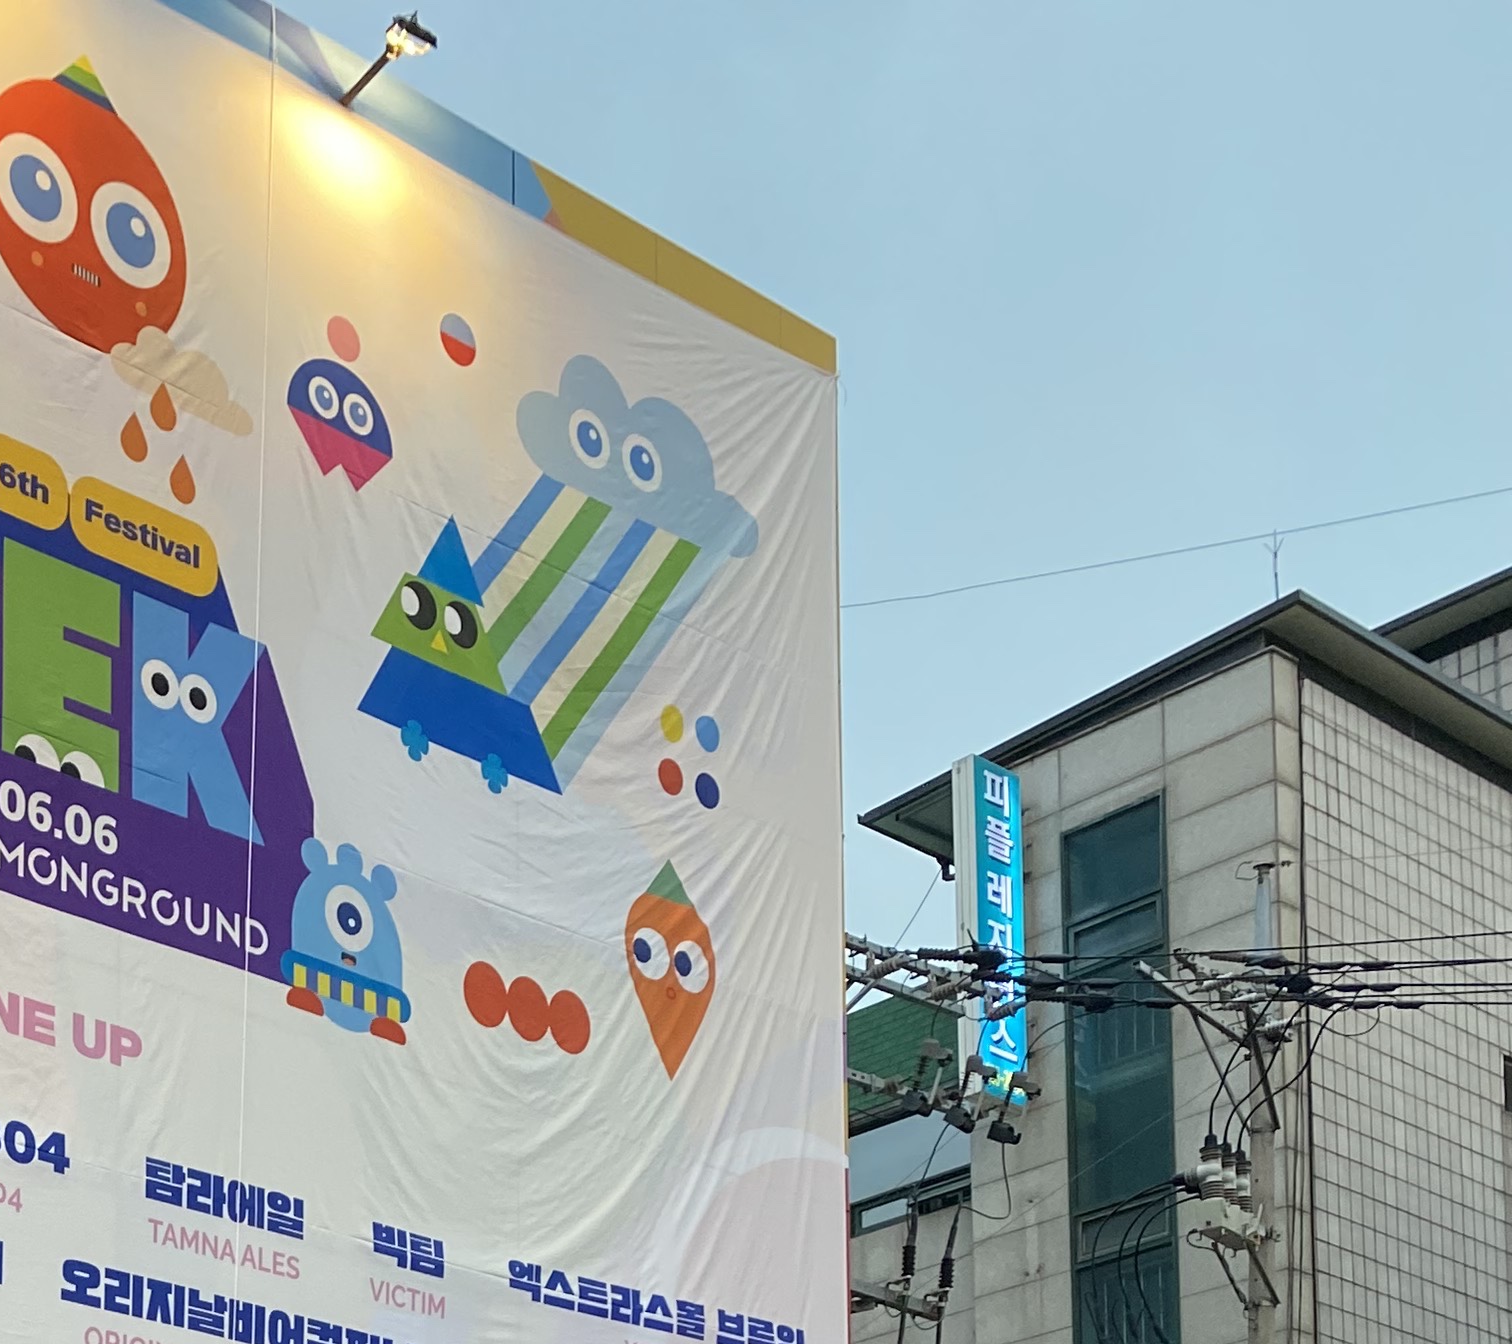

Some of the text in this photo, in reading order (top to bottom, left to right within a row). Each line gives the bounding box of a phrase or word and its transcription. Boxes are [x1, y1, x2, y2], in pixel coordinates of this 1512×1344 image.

[84, 499, 200, 570] Festival
[72, 1012, 140, 1075] UP
[145, 1156, 304, 1241] 탐라에일
[148, 1218, 300, 1280] TAMNA ALES
[372, 1221, 444, 1279] 빅팀
[369, 1277, 446, 1320] VICTIM
[508, 1259, 705, 1341] 엑스트라스몰
